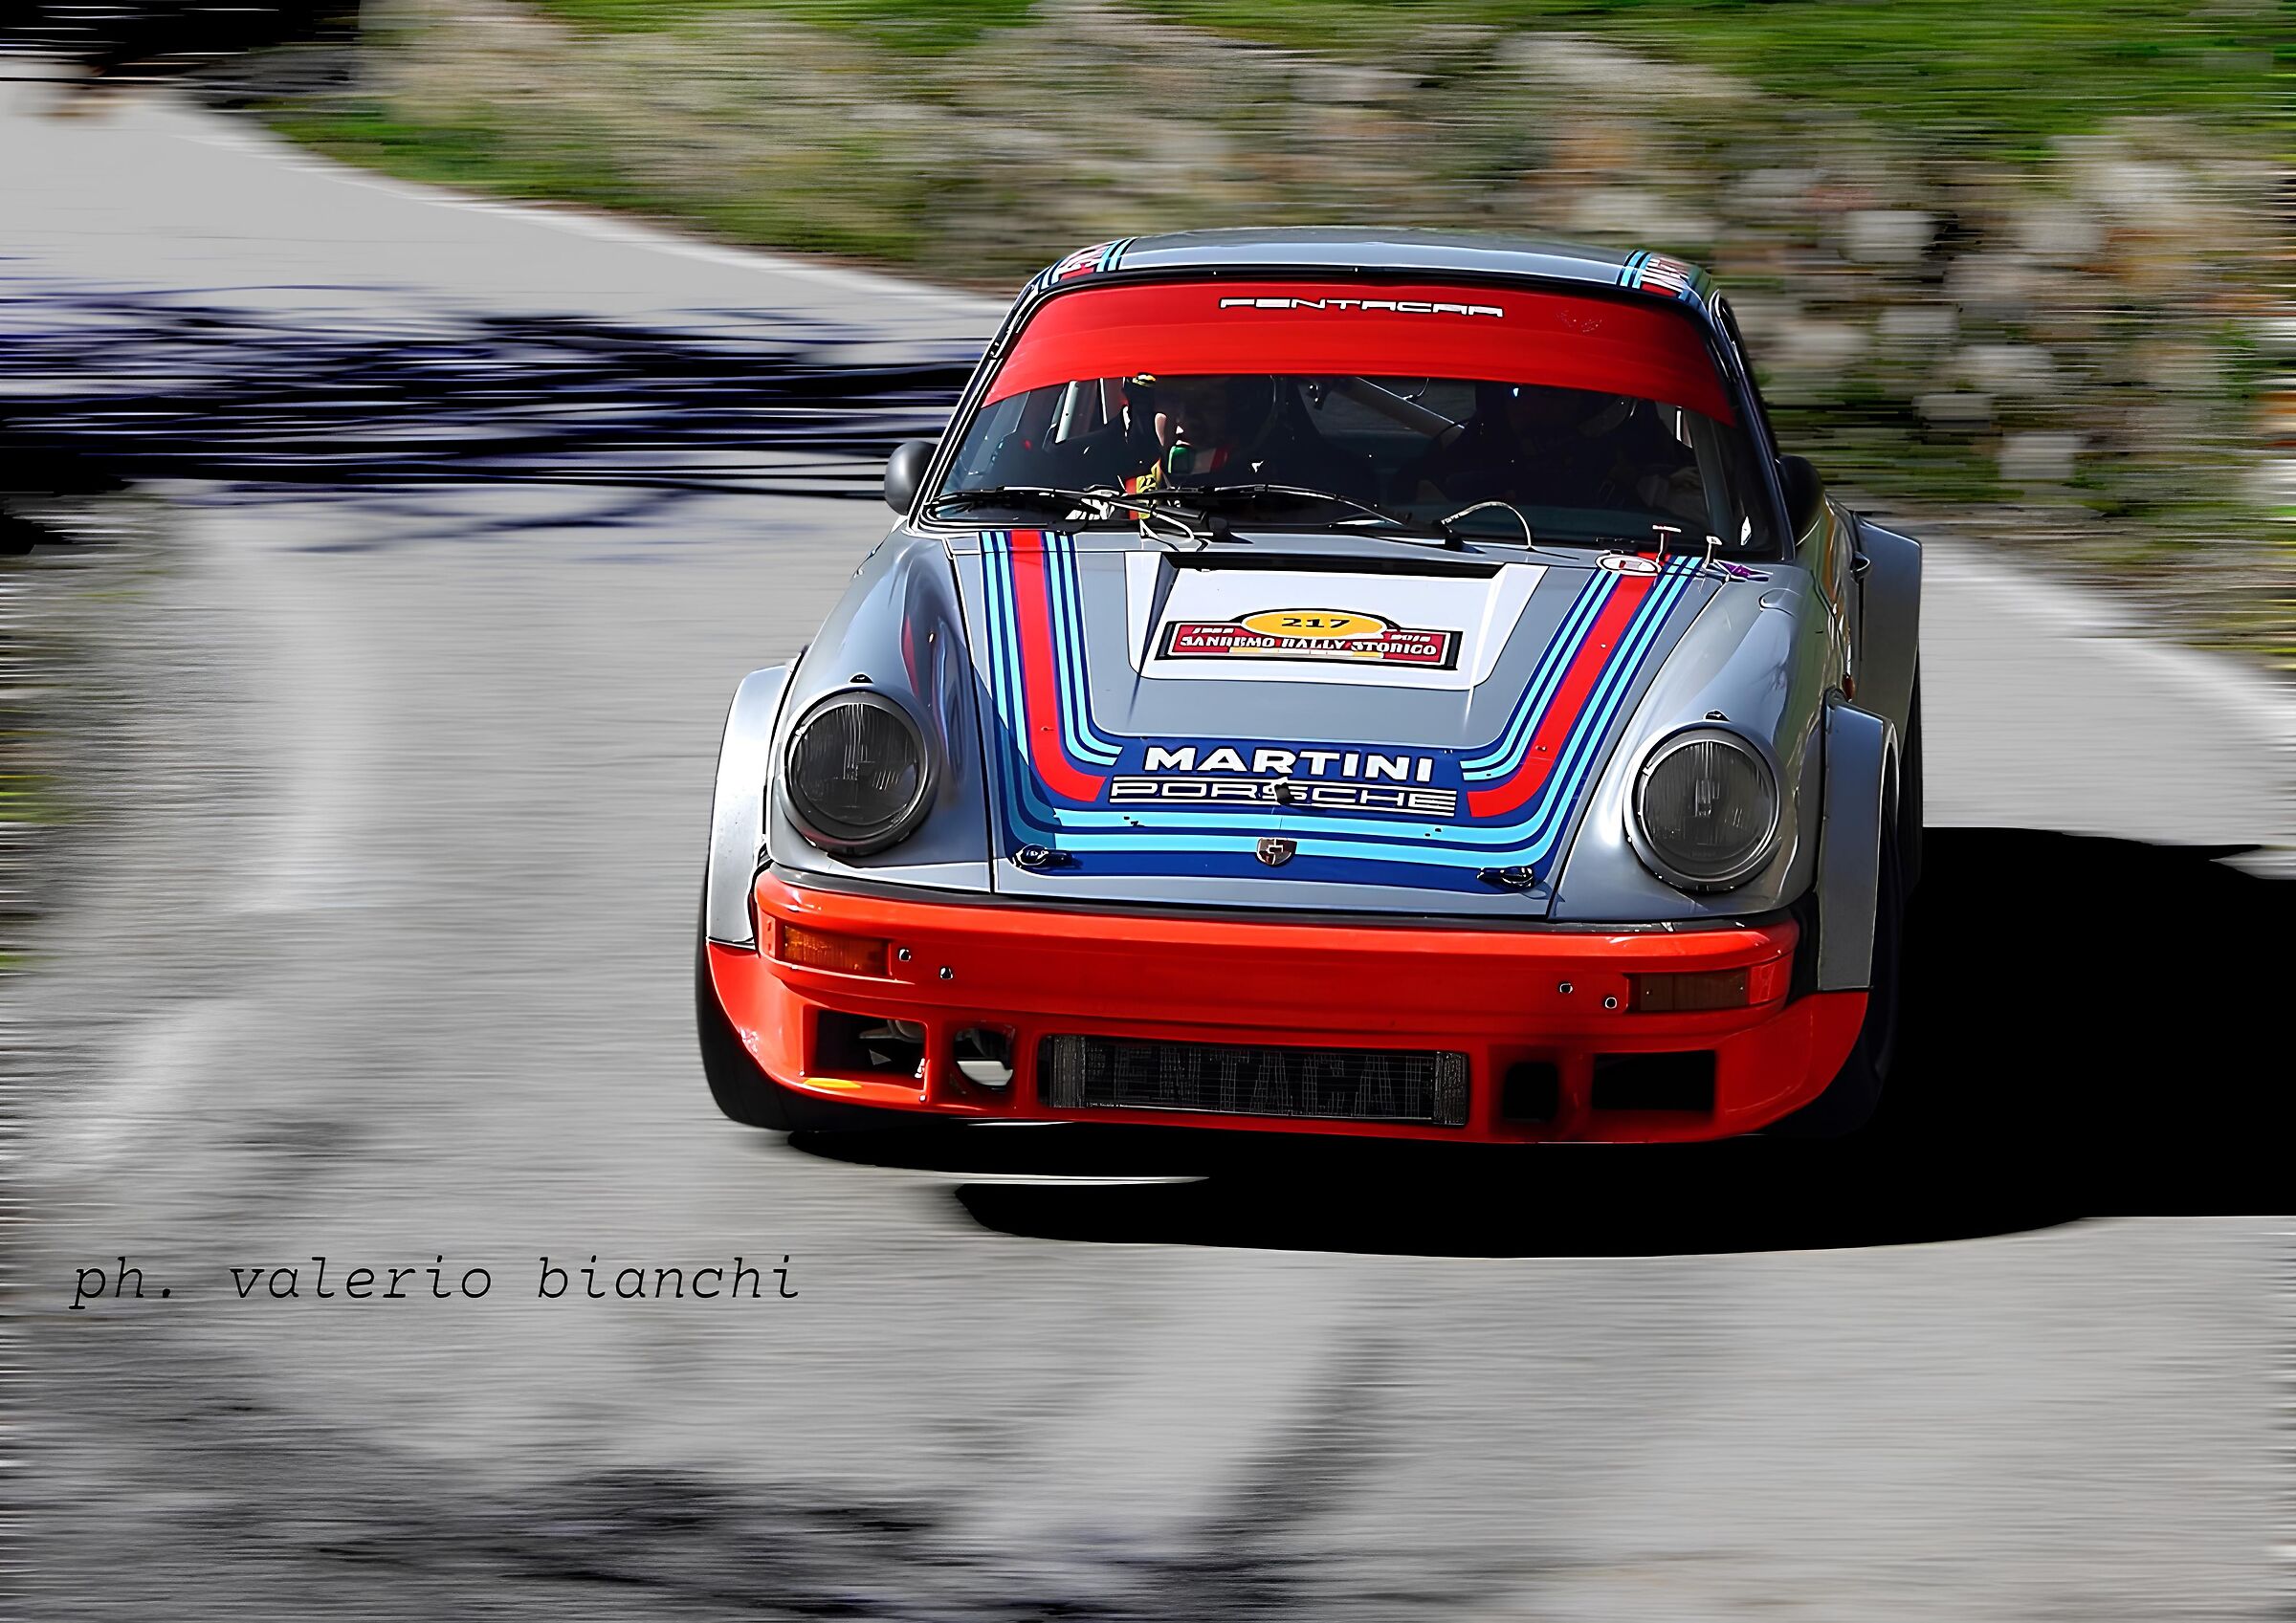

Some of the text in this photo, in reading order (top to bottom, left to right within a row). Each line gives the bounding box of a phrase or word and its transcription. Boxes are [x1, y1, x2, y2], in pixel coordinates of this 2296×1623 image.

[1281, 617, 1351, 628] 217
[1180, 635, 1437, 656] SANREMO RALLY STORICO
[1143, 746, 1434, 783] MARTINI
[1110, 779, 1457, 816] PORSCHE
